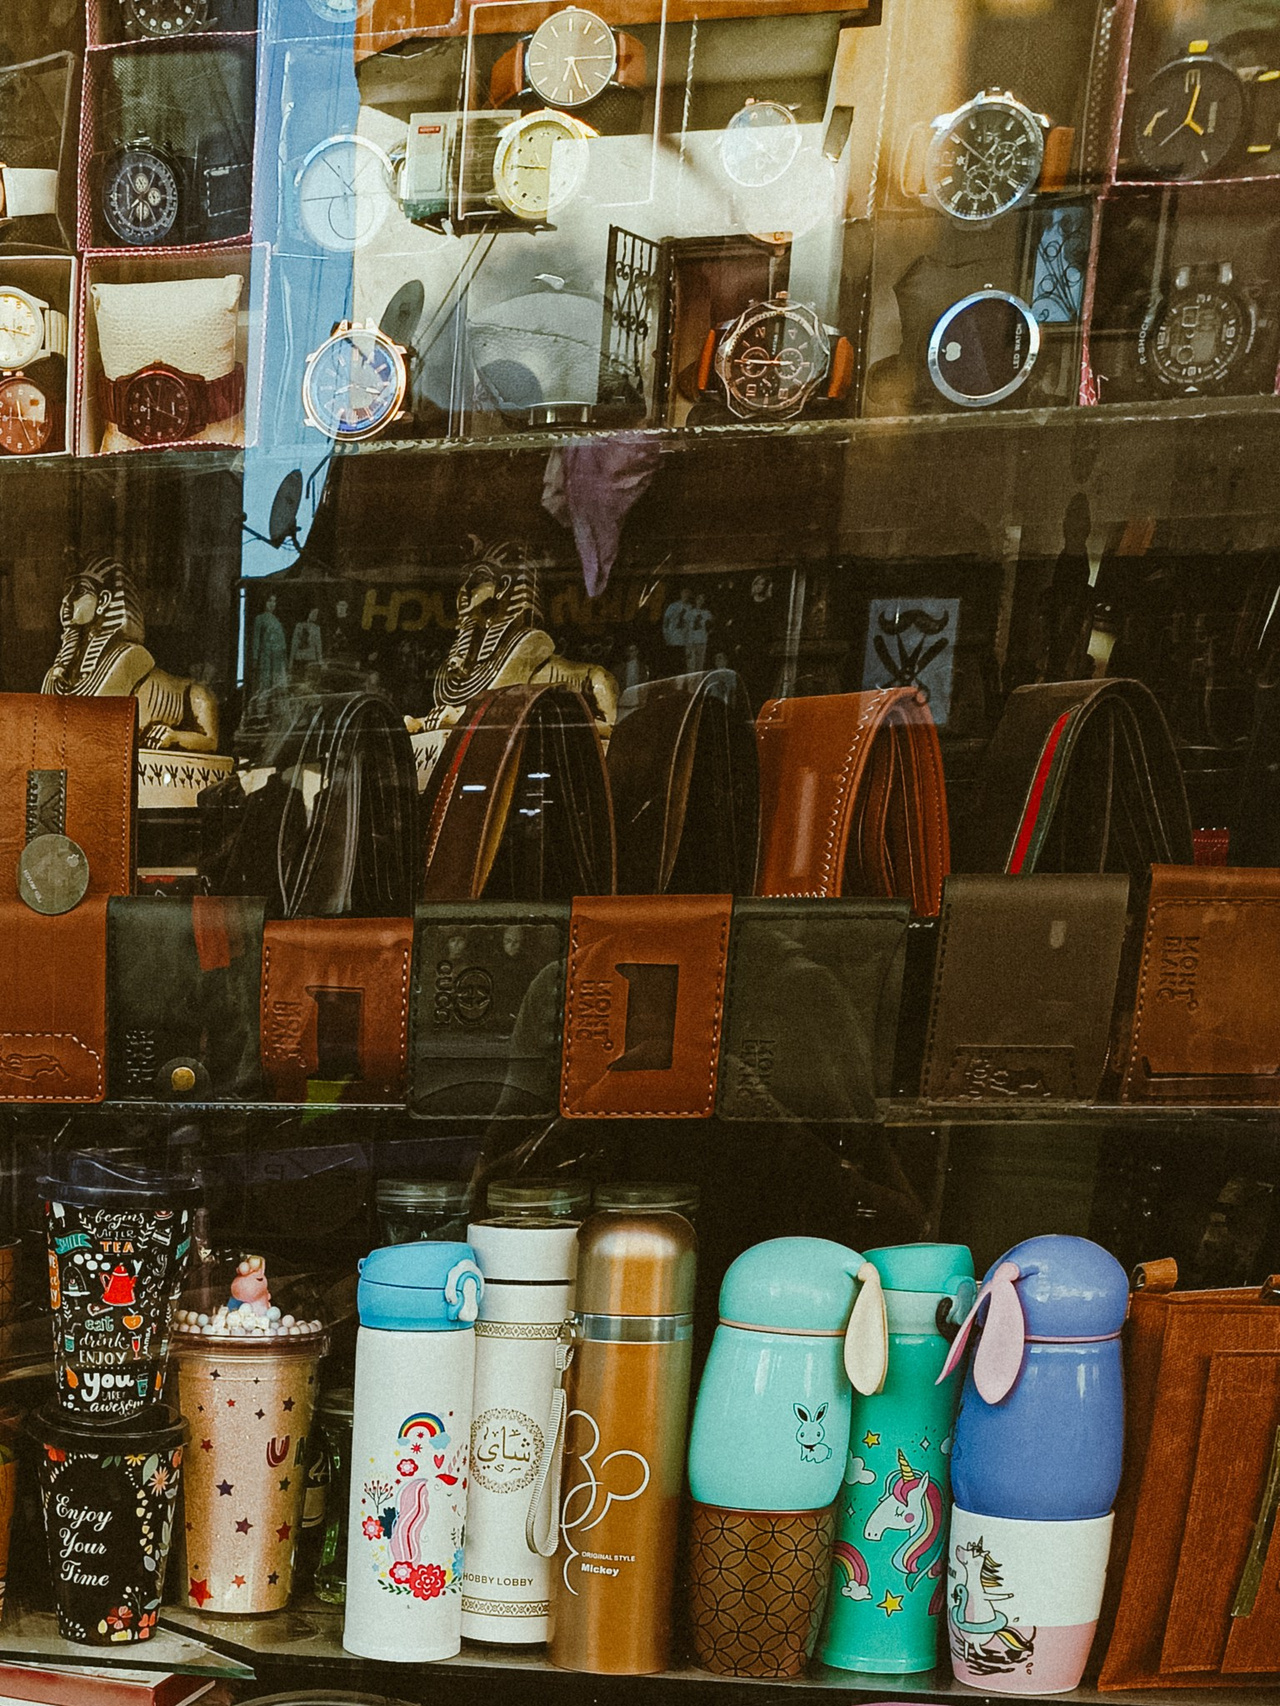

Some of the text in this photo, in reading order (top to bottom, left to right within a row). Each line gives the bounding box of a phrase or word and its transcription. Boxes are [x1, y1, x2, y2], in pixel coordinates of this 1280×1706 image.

[1013, 322, 1024, 369] LED WATCH
[433, 959, 454, 1031] GUCCI
[94, 1208, 146, 1231] begins
[99, 1240, 135, 1254] TEA
[84, 1315, 115, 1332] eat
[78, 1331, 131, 1348] drink
[79, 1350, 127, 1366] ENJOY
[80, 1372, 135, 1402] you
[55, 1493, 114, 1532] Enjoy
[58, 1526, 108, 1559] Your
[581, 1551, 636, 1563] ORIGINAL STYLE
[60, 1558, 110, 1588] Time
[462, 1572, 534, 1588] HOBBY LOBBY
[580, 1562, 620, 1578] Mickey
